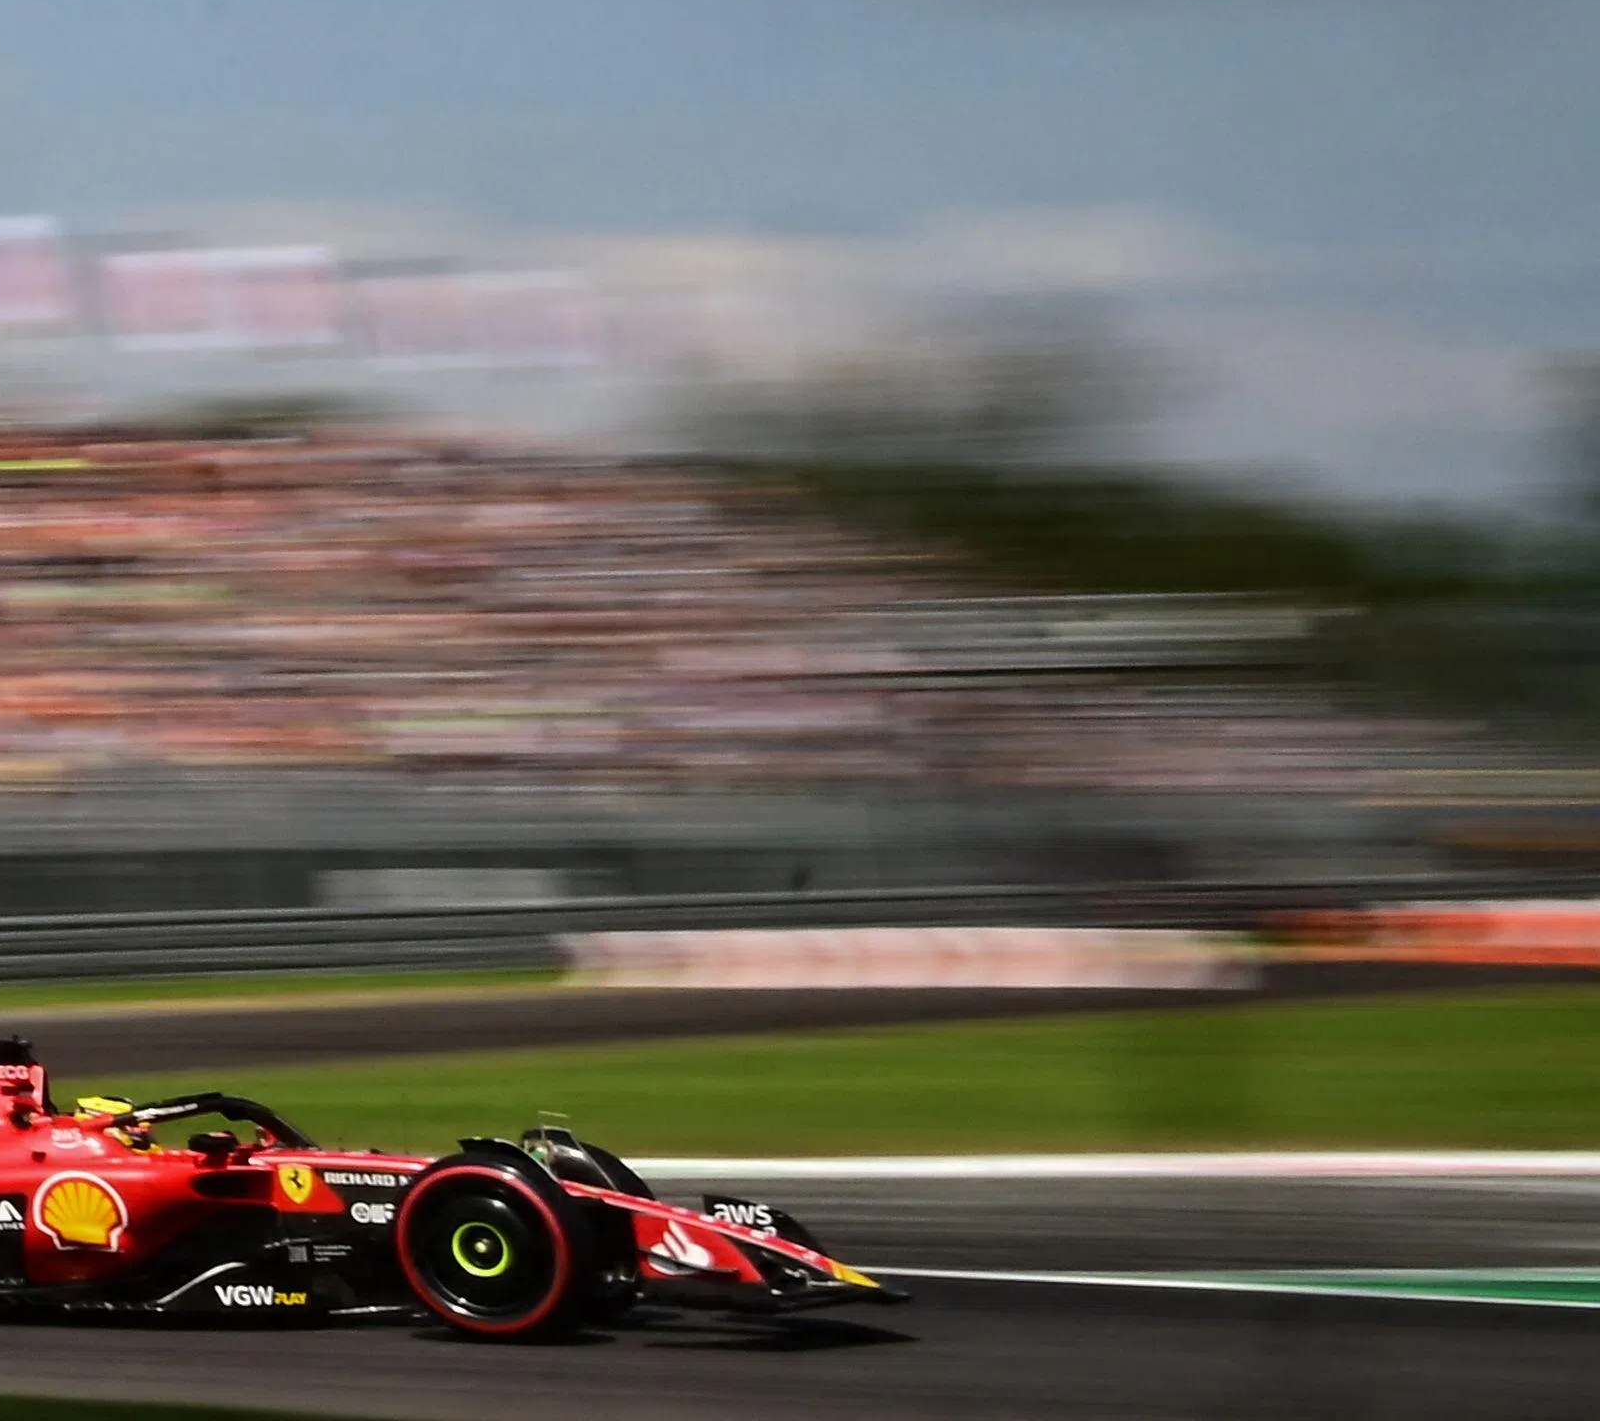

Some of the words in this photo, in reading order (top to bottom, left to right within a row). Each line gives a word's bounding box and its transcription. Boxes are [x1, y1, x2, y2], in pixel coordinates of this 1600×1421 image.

[324, 1171, 396, 1187] RICHARD
[713, 1203, 773, 1225] aws
[214, 1285, 274, 1306] VGW
